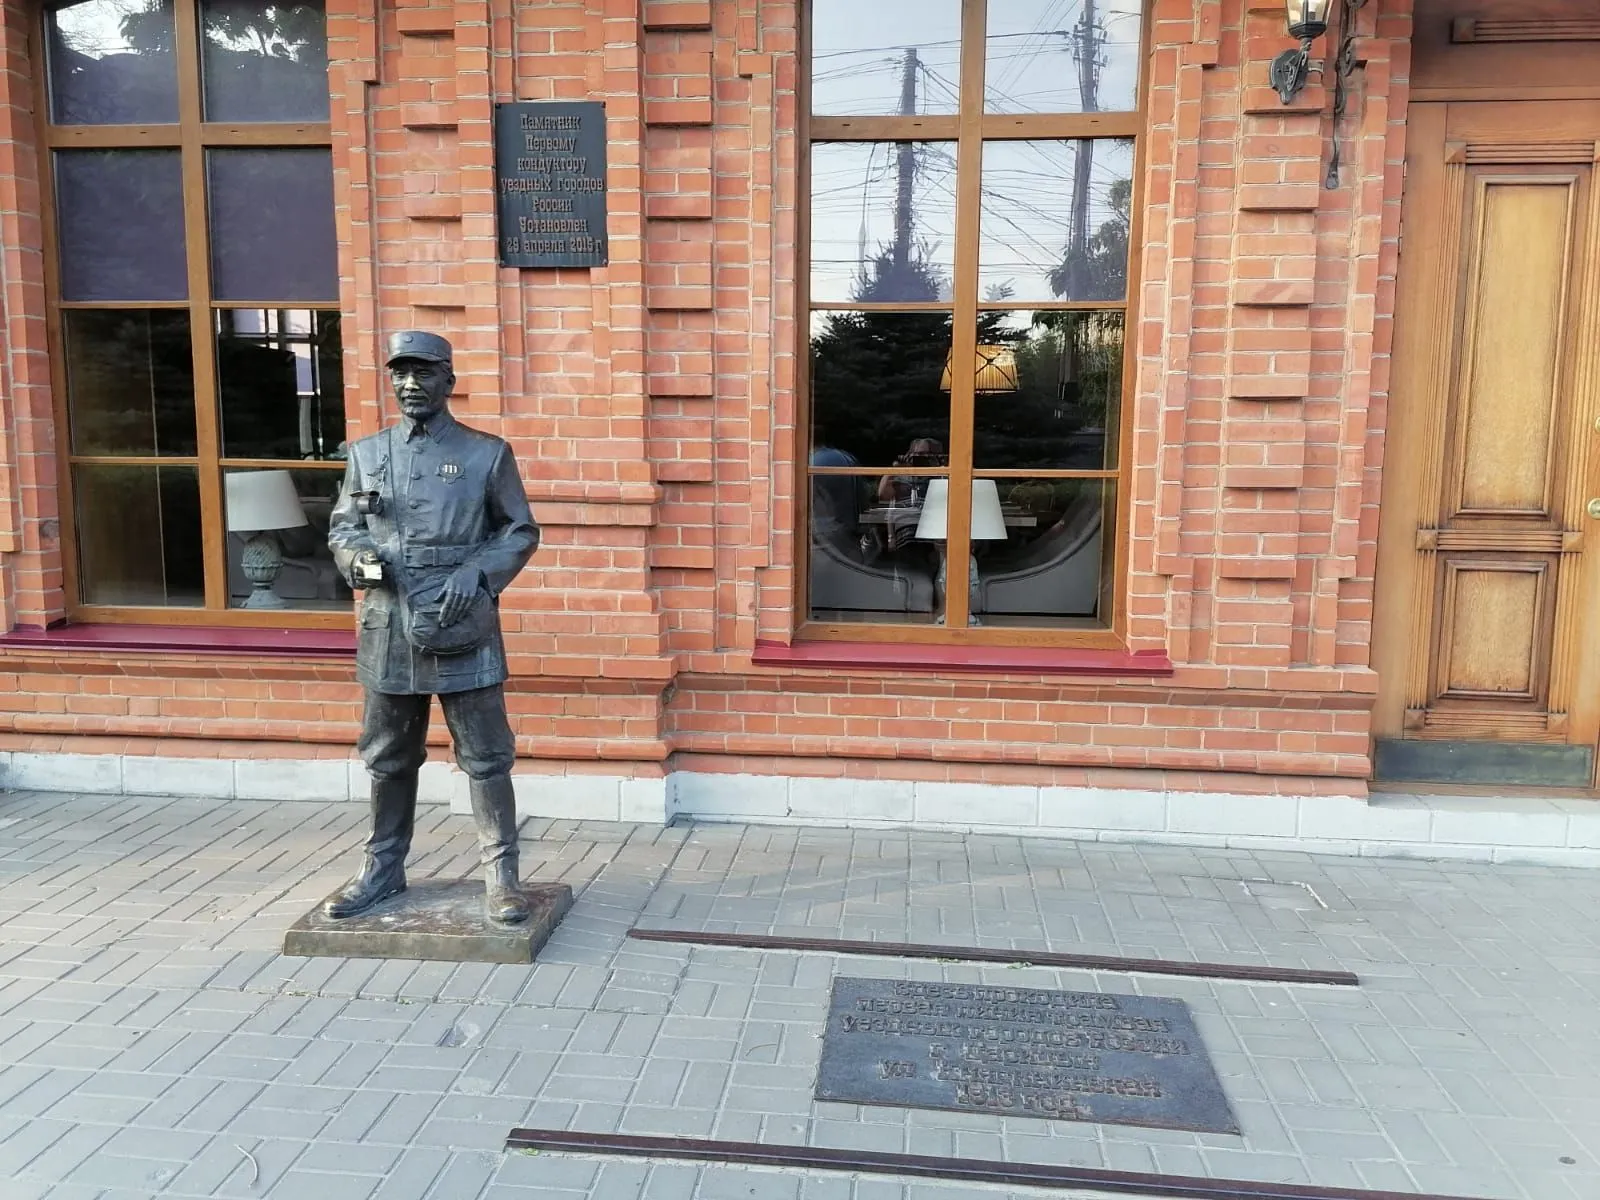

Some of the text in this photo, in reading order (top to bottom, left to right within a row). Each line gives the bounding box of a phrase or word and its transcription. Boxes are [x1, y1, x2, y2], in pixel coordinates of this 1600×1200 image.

[519, 113, 582, 131] Памятник
[525, 134, 576, 153] Первому
[517, 156, 587, 174] кондуктору
[501, 177, 604, 194] уездных городов
[531, 196, 573, 212] России
[518, 216, 588, 234] Установлен
[523, 239, 565, 256] апреля
